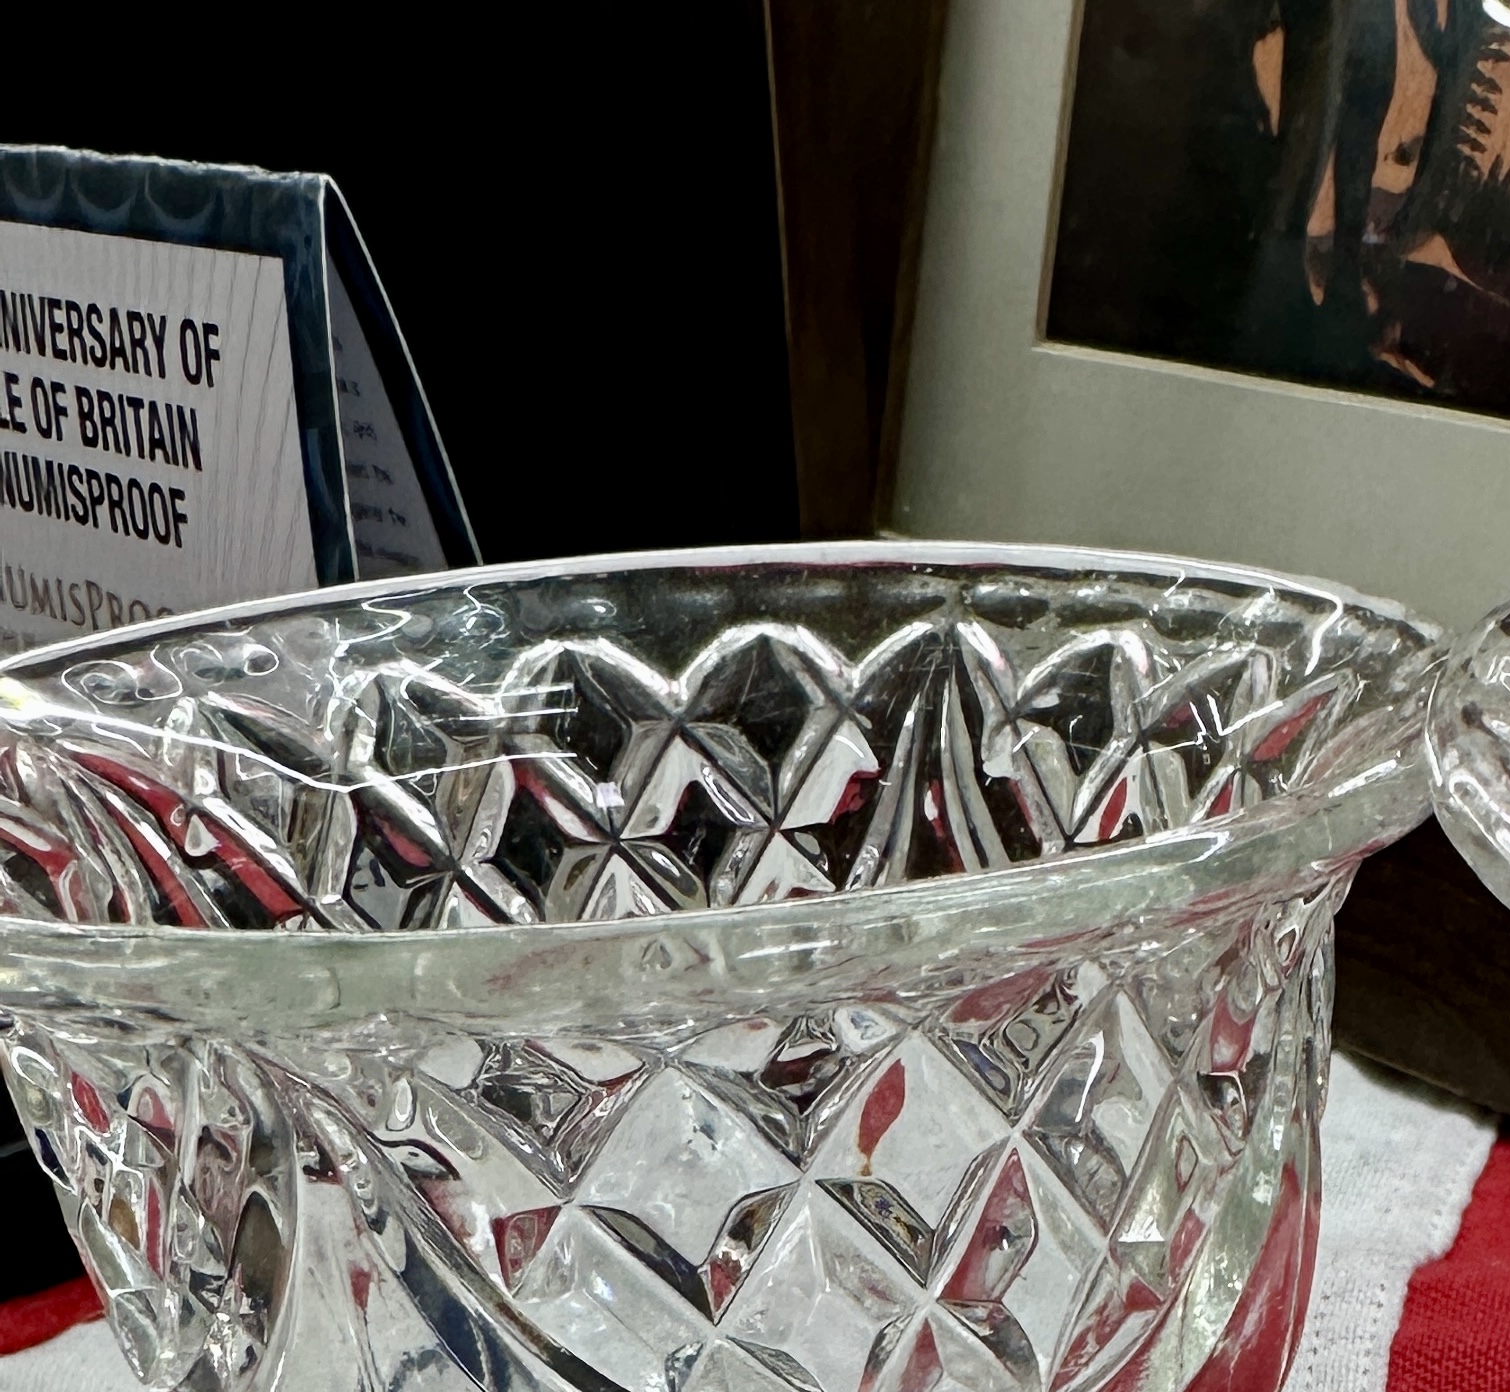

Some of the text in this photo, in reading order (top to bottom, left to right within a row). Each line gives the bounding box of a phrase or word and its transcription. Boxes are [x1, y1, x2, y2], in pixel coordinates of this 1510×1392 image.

[0, 289, 220, 388] NIVERSARY OF
[31, 376, 68, 441] OF
[75, 385, 202, 472] BRITAIN
[0, 451, 188, 548] NUMISPROOF
[0, 563, 175, 630] UMISPRO
